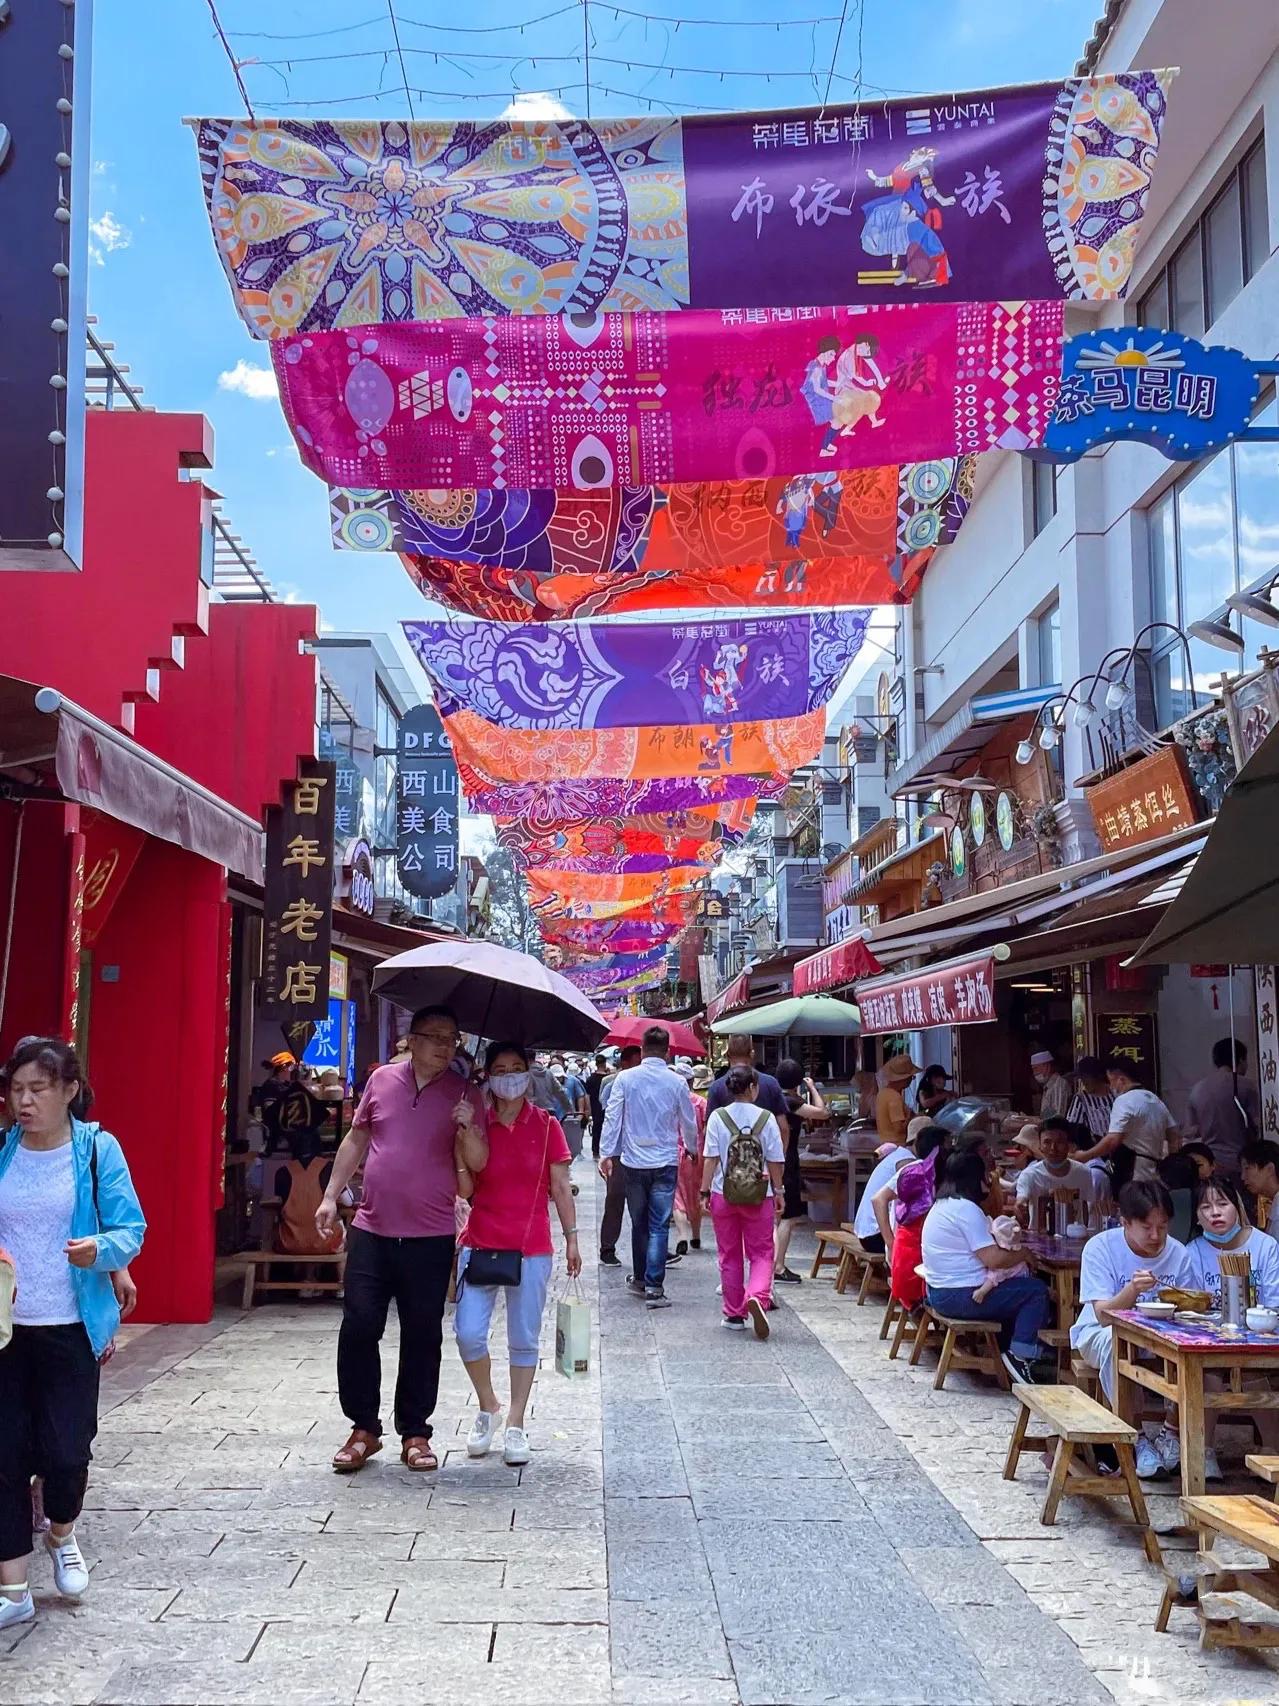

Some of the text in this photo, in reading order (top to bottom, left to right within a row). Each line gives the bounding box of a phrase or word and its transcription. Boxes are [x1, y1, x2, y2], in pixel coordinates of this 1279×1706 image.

[933, 102, 995, 123] YUNTAI
[954, 165, 1013, 225] 族
[1053, 365, 1218, 424] 茶马昆明
[668, 653, 790, 691] 白 族
[400, 768, 456, 798] 西山
[400, 806, 455, 835] 美食
[400, 842, 455, 872] 公司
[279, 776, 328, 1005] 百年老店
